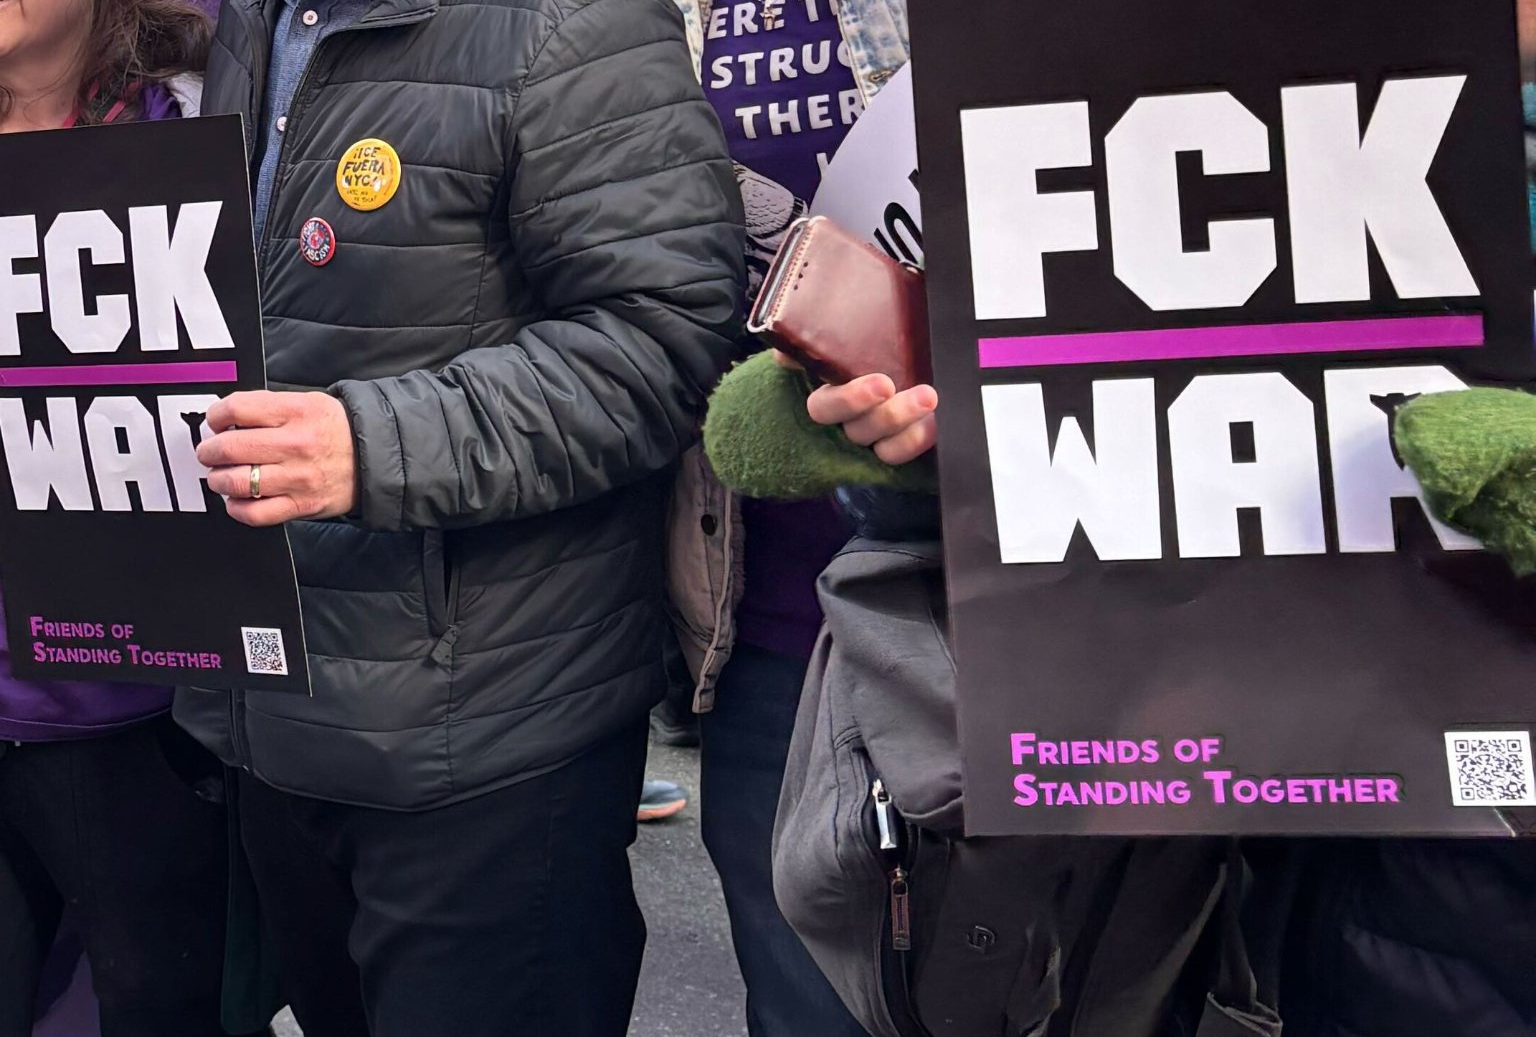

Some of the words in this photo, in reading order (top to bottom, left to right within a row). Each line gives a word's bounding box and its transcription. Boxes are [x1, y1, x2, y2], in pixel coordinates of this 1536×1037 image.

[342, 159, 385, 176] FUERA
[960, 74, 1482, 321] FCK
[30, 616, 105, 639] FRIENDS
[111, 622, 134, 639] OF
[33, 642, 122, 665] STANDING
[125, 644, 222, 670] TOGETHER
[1010, 732, 1161, 765] FRIENDS
[1174, 737, 1221, 764] OF
[1012, 772, 1192, 807] STANDING
[1204, 769, 1400, 805] TOGETHER
